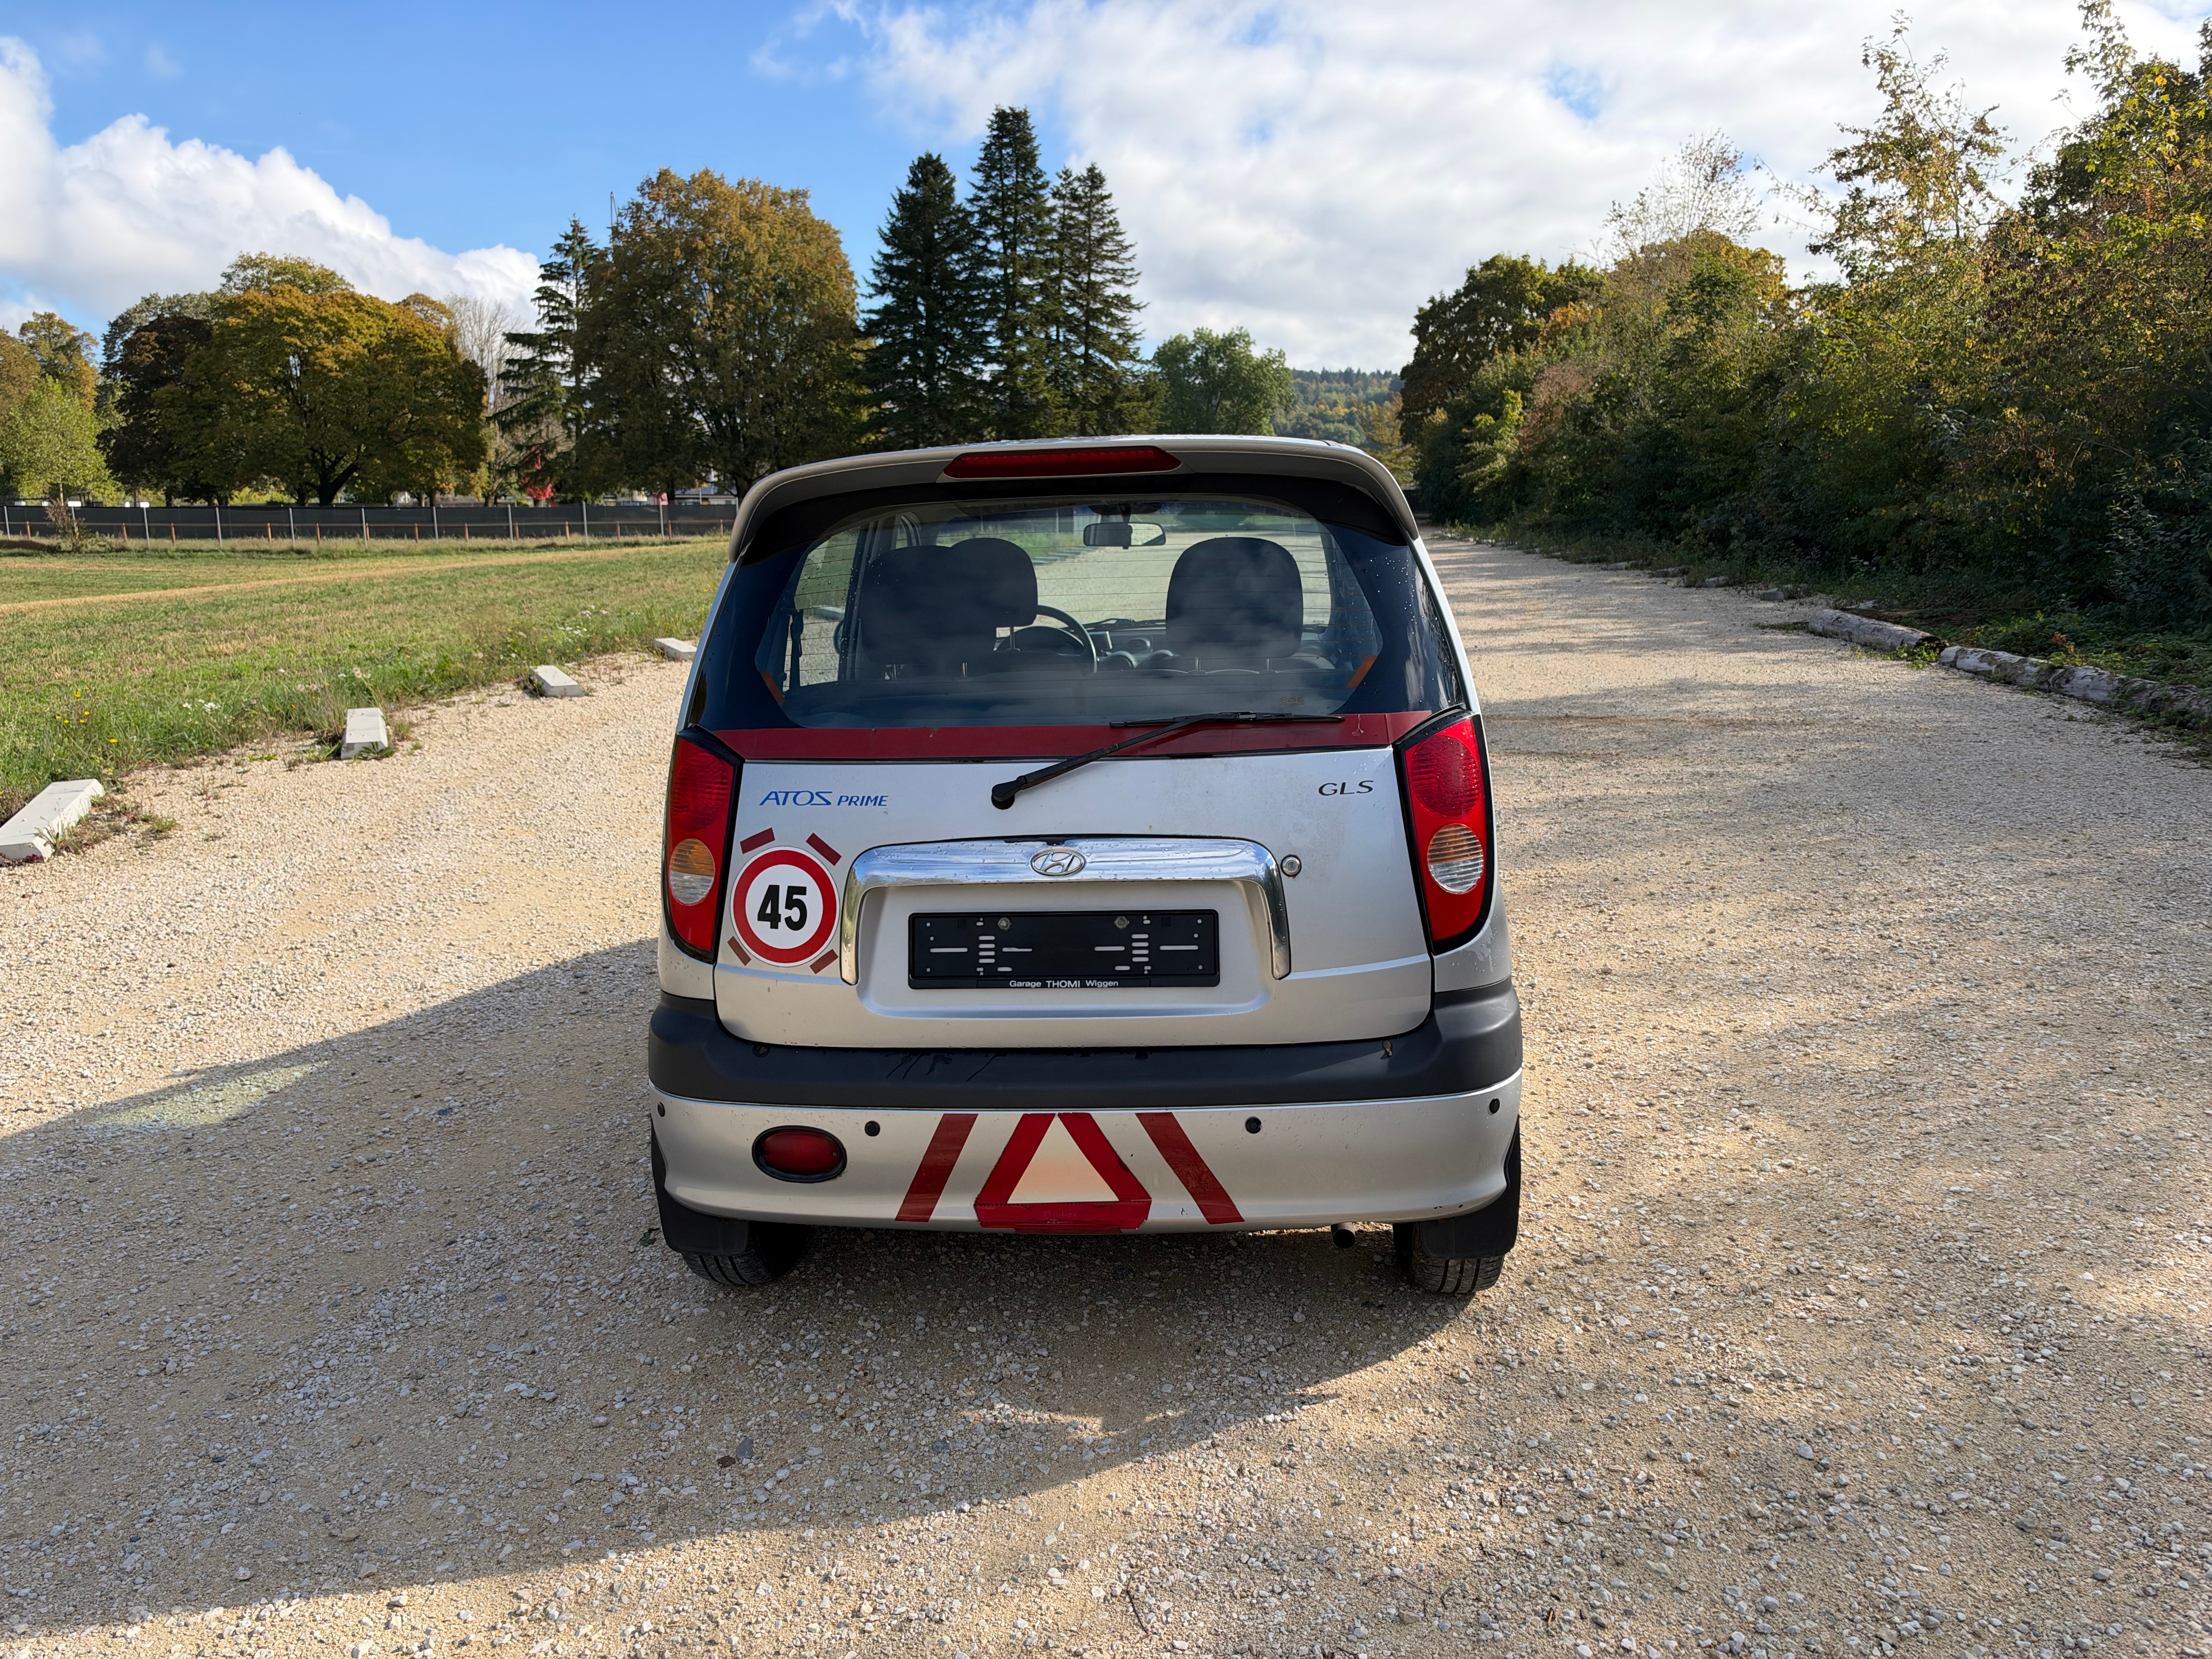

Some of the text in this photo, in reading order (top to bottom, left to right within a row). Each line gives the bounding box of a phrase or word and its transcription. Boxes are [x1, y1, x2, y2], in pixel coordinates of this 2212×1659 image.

[1319, 780, 1374, 796] GLS
[759, 790, 888, 806] ATOS PRIME
[757, 884, 807, 931] 45
[1085, 980, 1118, 988] Wiggen
